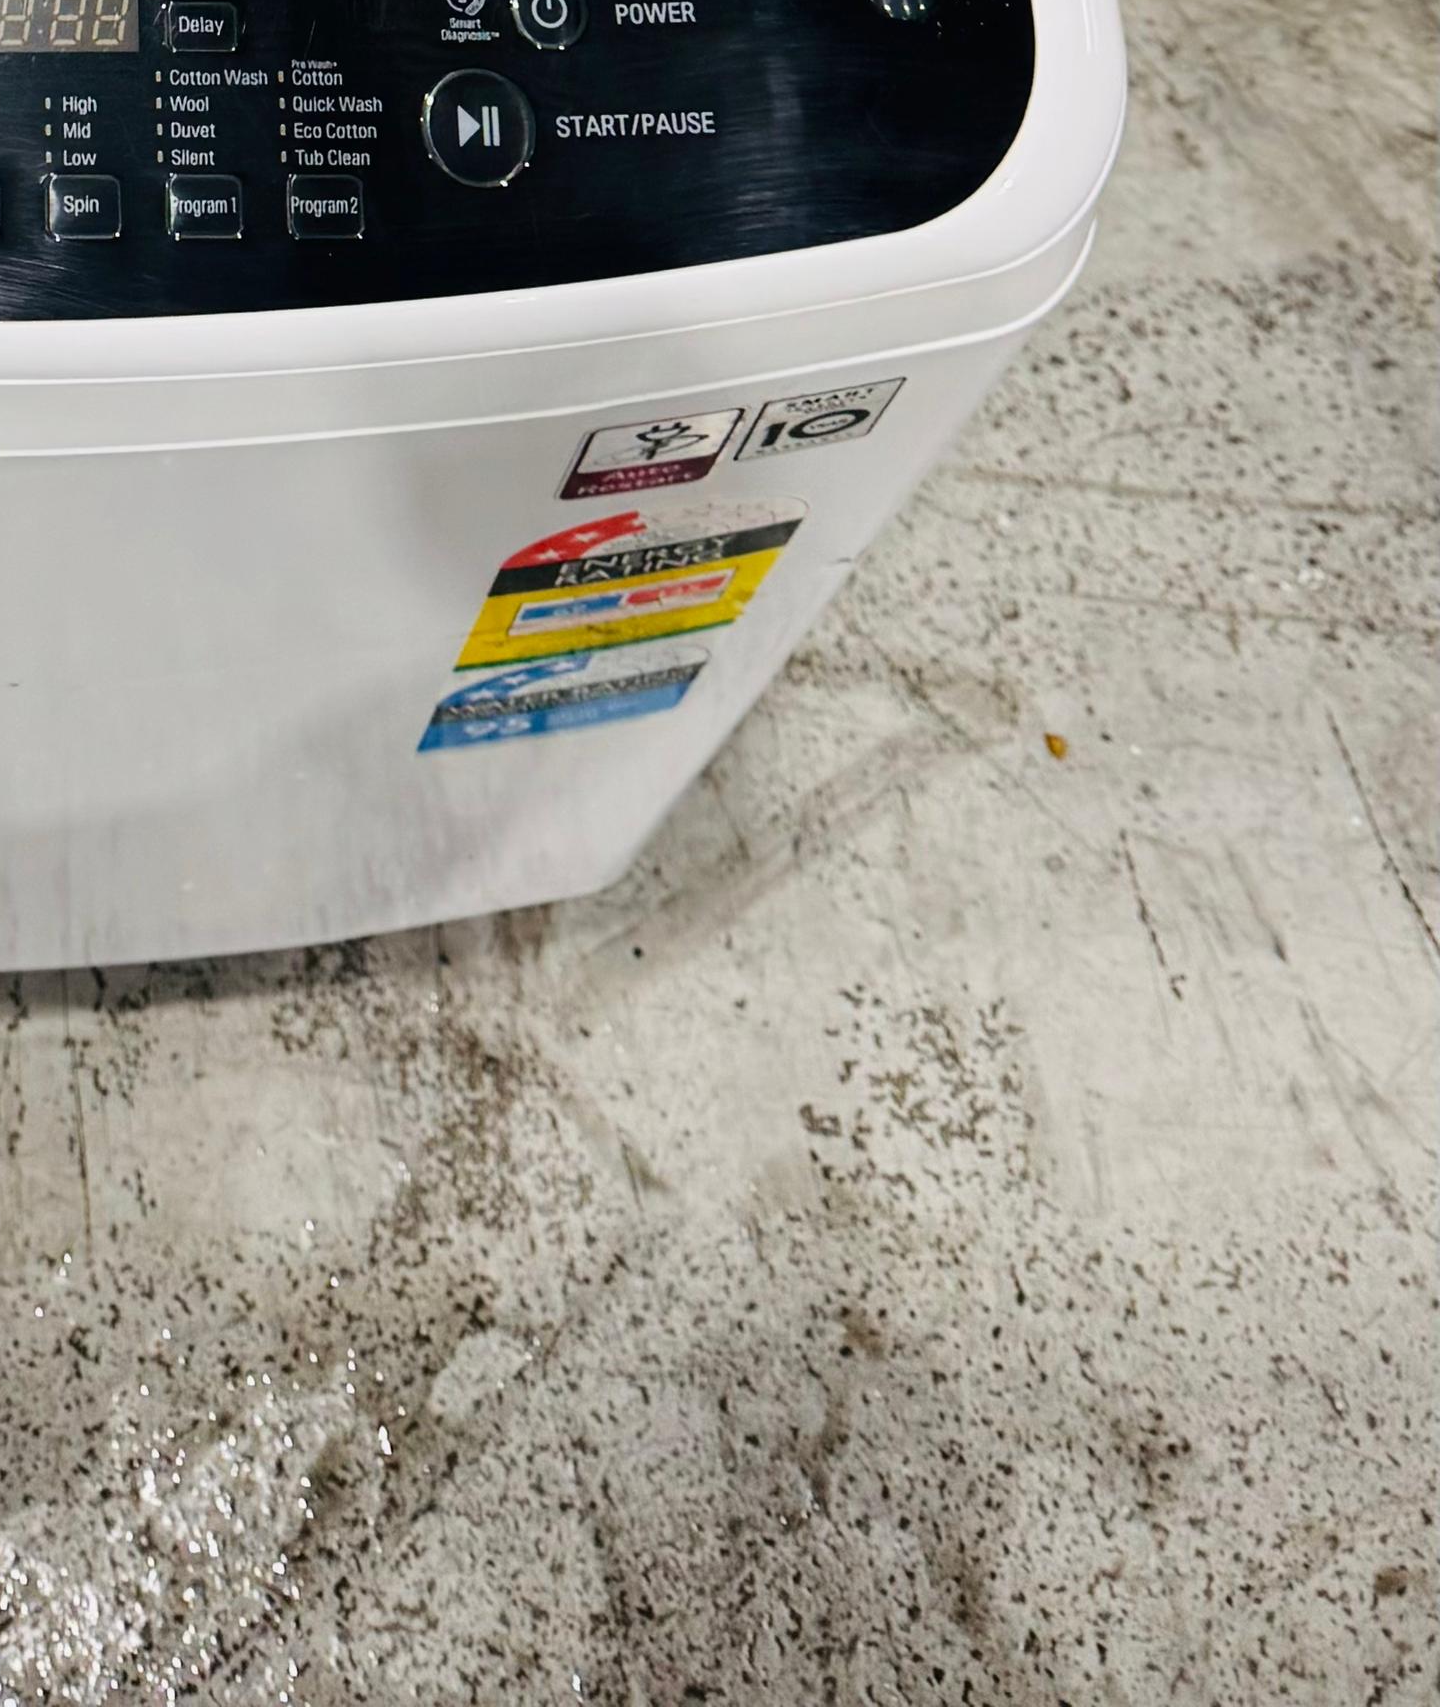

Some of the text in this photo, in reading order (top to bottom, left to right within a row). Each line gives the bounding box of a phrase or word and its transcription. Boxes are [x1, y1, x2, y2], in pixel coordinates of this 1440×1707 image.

[449, 17, 481, 29] Smart
[614, 1, 696, 27] POWER
[178, 16, 224, 36] Delay
[169, 69, 268, 86] Cotton Wash
[291, 69, 343, 87] Cotton
[62, 95, 98, 115] High
[169, 95, 210, 112] Wool
[292, 95, 383, 113] Quick Wash
[63, 122, 92, 139] Mid
[171, 122, 216, 139] Duvet
[293, 122, 378, 139] Eco Cotton
[555, 111, 716, 139] START/PAUSE
[63, 150, 97, 166] Low
[171, 149, 215, 167] Silent
[294, 149, 371, 167] Tub Clean
[63, 195, 100, 217] Spin
[172, 196, 237, 217] Program 1
[290, 196, 359, 218] Program 2
